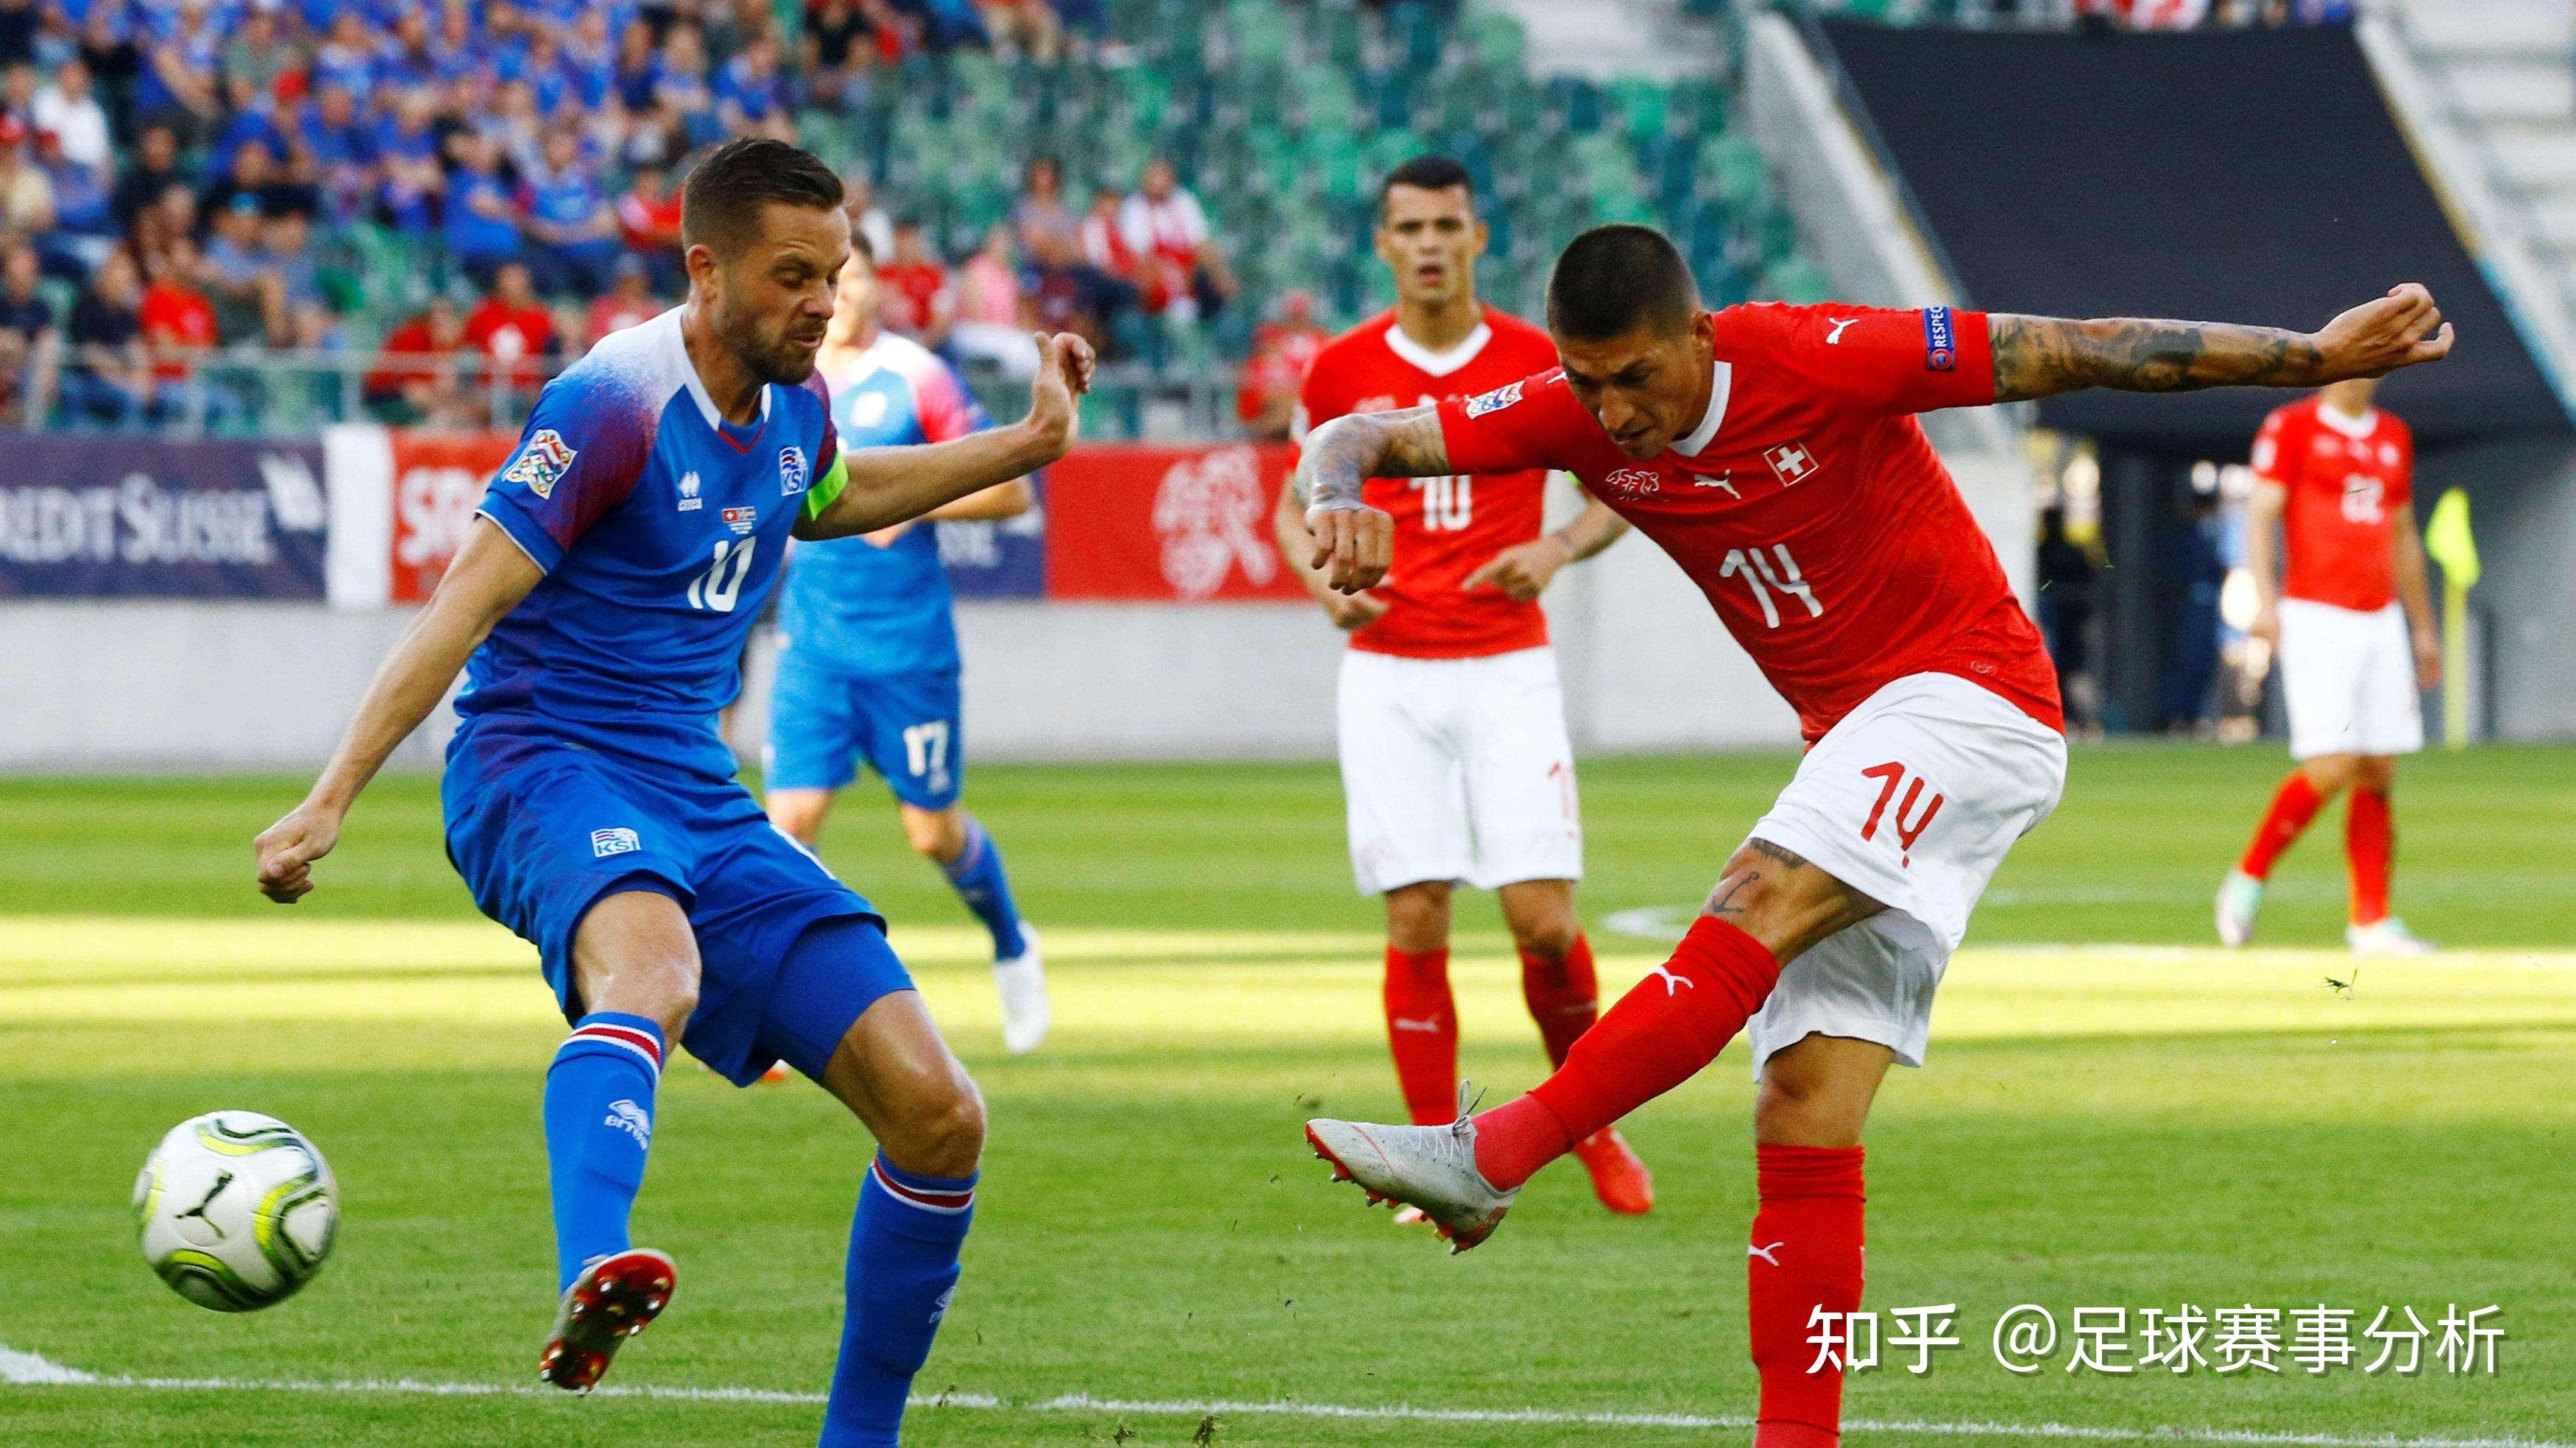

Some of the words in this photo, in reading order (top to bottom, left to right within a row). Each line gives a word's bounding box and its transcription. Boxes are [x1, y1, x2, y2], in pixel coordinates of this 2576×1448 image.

[1408, 475, 1472, 531] 10
[687, 536, 757, 612] 10
[1719, 543, 1824, 629] 14
[903, 719, 952, 794] 17
[1861, 761, 1944, 869] 14
